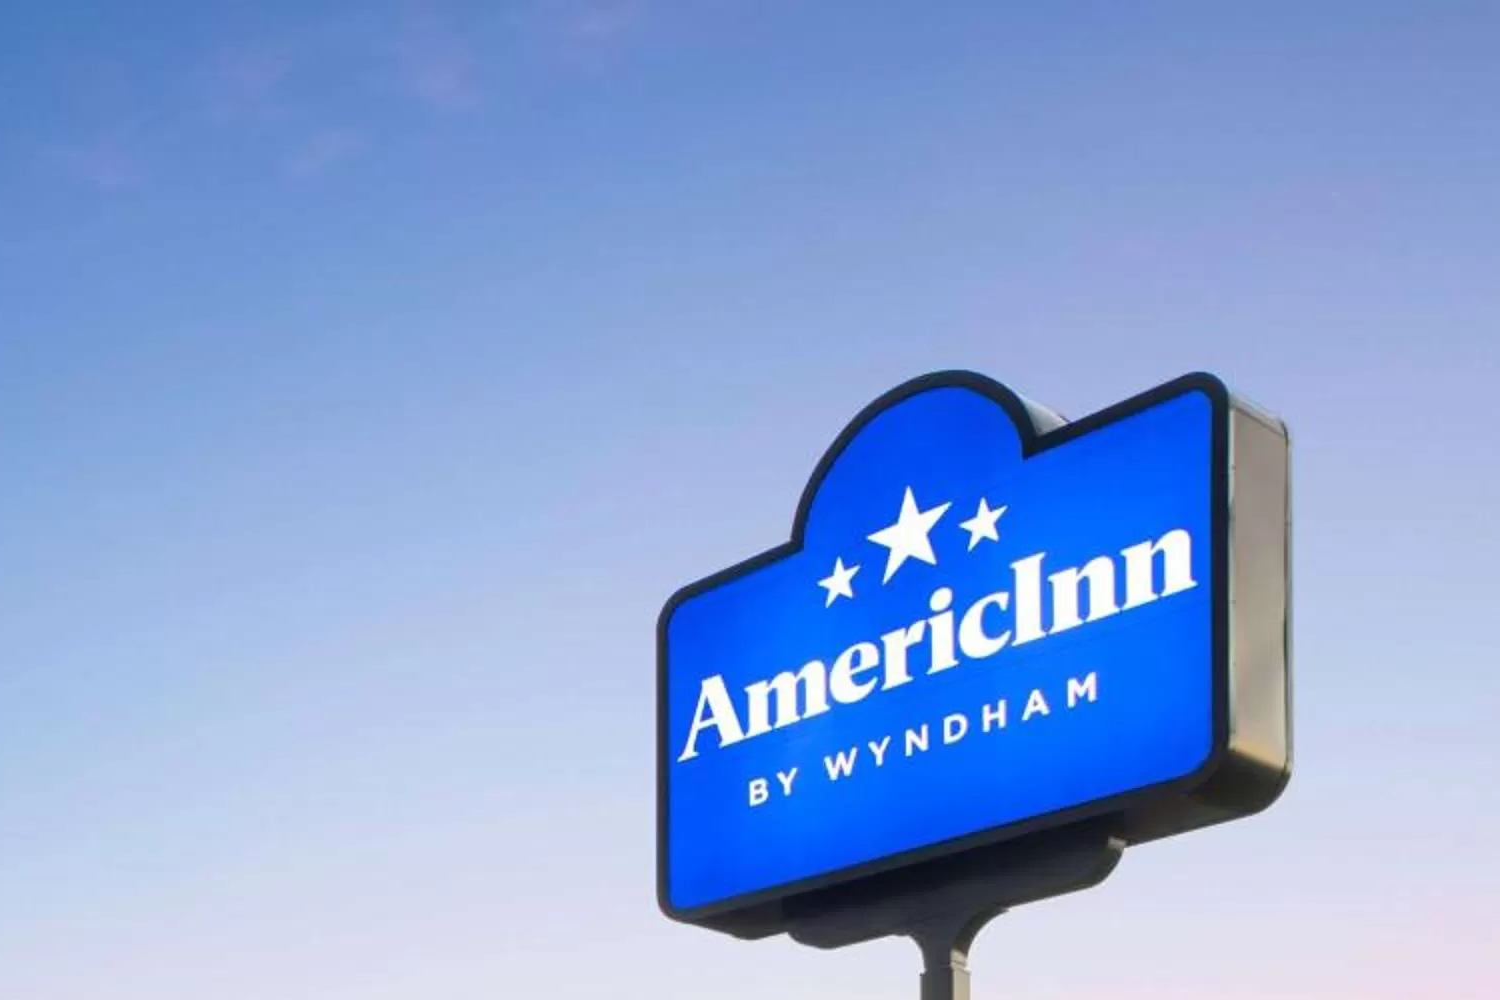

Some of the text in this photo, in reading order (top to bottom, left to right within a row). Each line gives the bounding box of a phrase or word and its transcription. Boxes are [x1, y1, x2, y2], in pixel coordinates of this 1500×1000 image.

[678, 528, 1198, 762] AmericInn
[748, 671, 1098, 806] BY WYNDHAM
